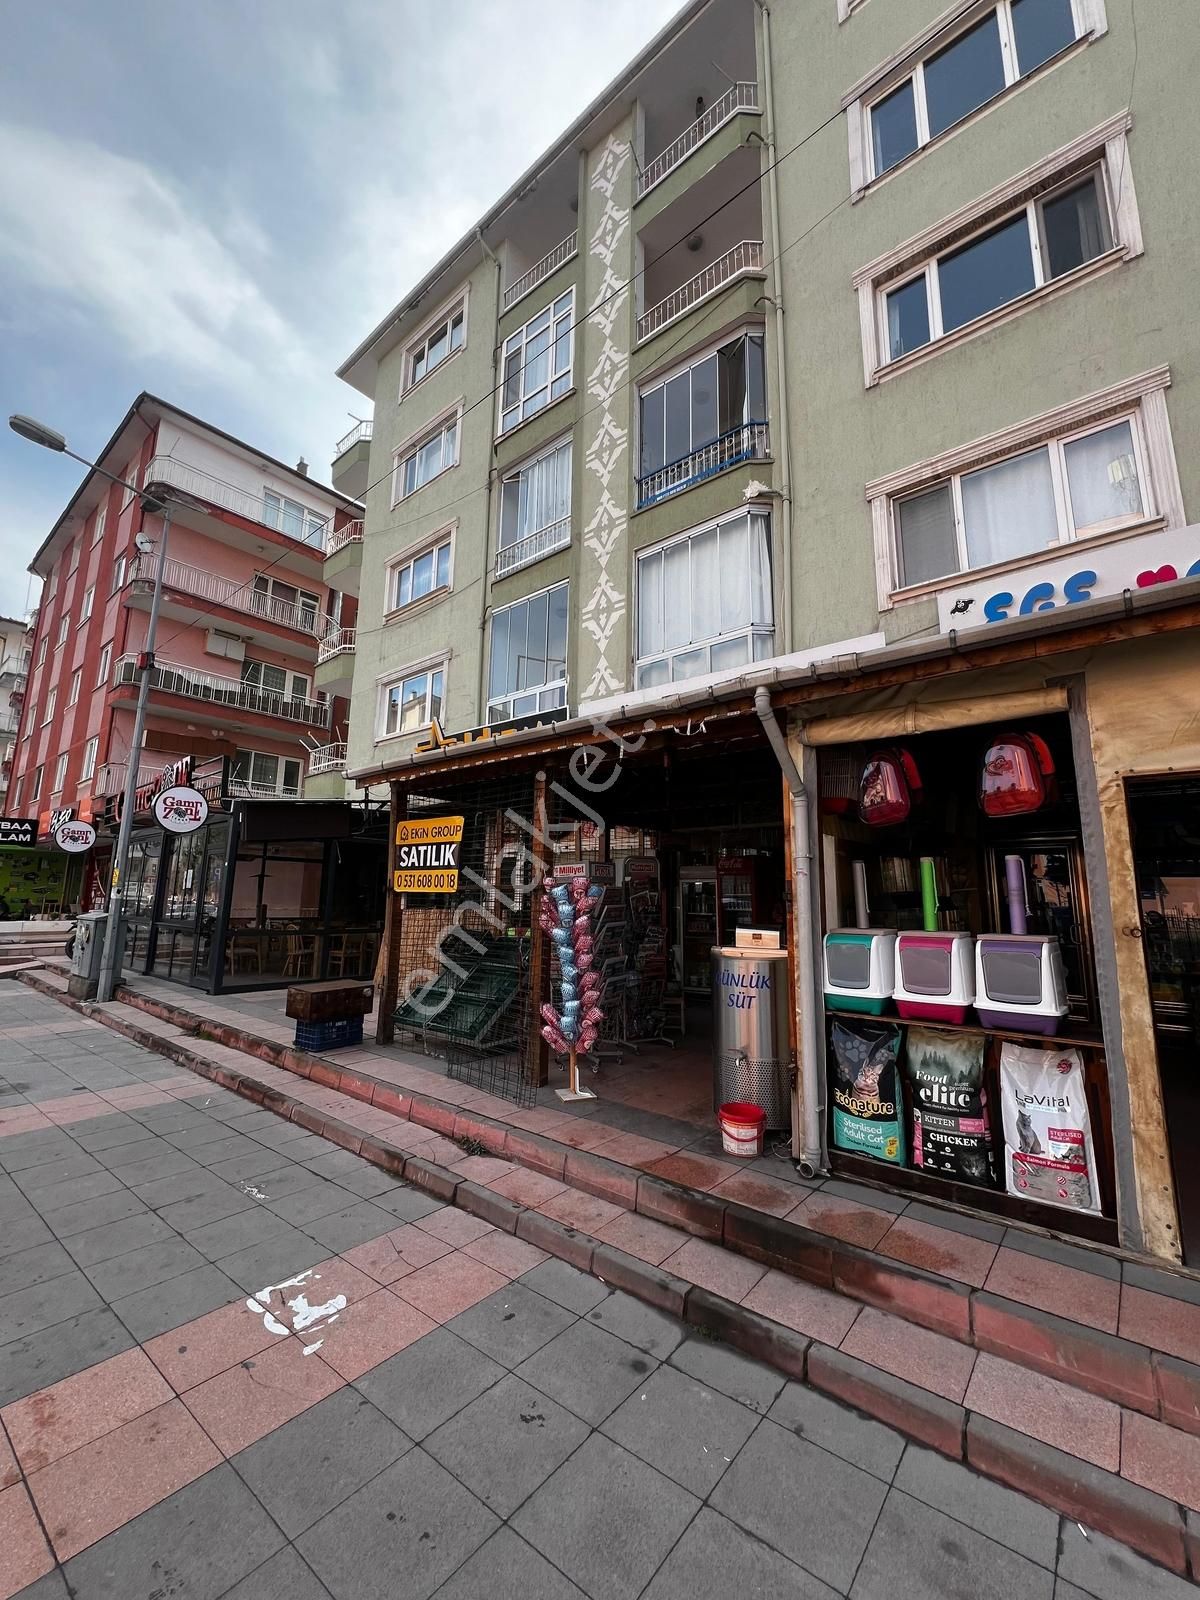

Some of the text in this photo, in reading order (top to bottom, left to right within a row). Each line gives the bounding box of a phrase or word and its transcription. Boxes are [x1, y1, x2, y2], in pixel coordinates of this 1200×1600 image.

[431, 825, 462, 838] GROUP
[400, 844, 457, 867] SATILIK
[560, 865, 584, 875] Milliyet
[397, 874, 456, 887] 0 531 608 00 18
[727, 992, 756, 1009] SÜT
[916, 1070, 947, 1084] Food
[919, 1083, 970, 1108] elite
[1015, 1089, 1070, 1107] LaVital
[924, 1114, 955, 1127] KITTEN
[843, 1126, 885, 1143] Adult Cat
[930, 1132, 978, 1147] CHICKEN
[1027, 1156, 1070, 1169] Salmon Formula
